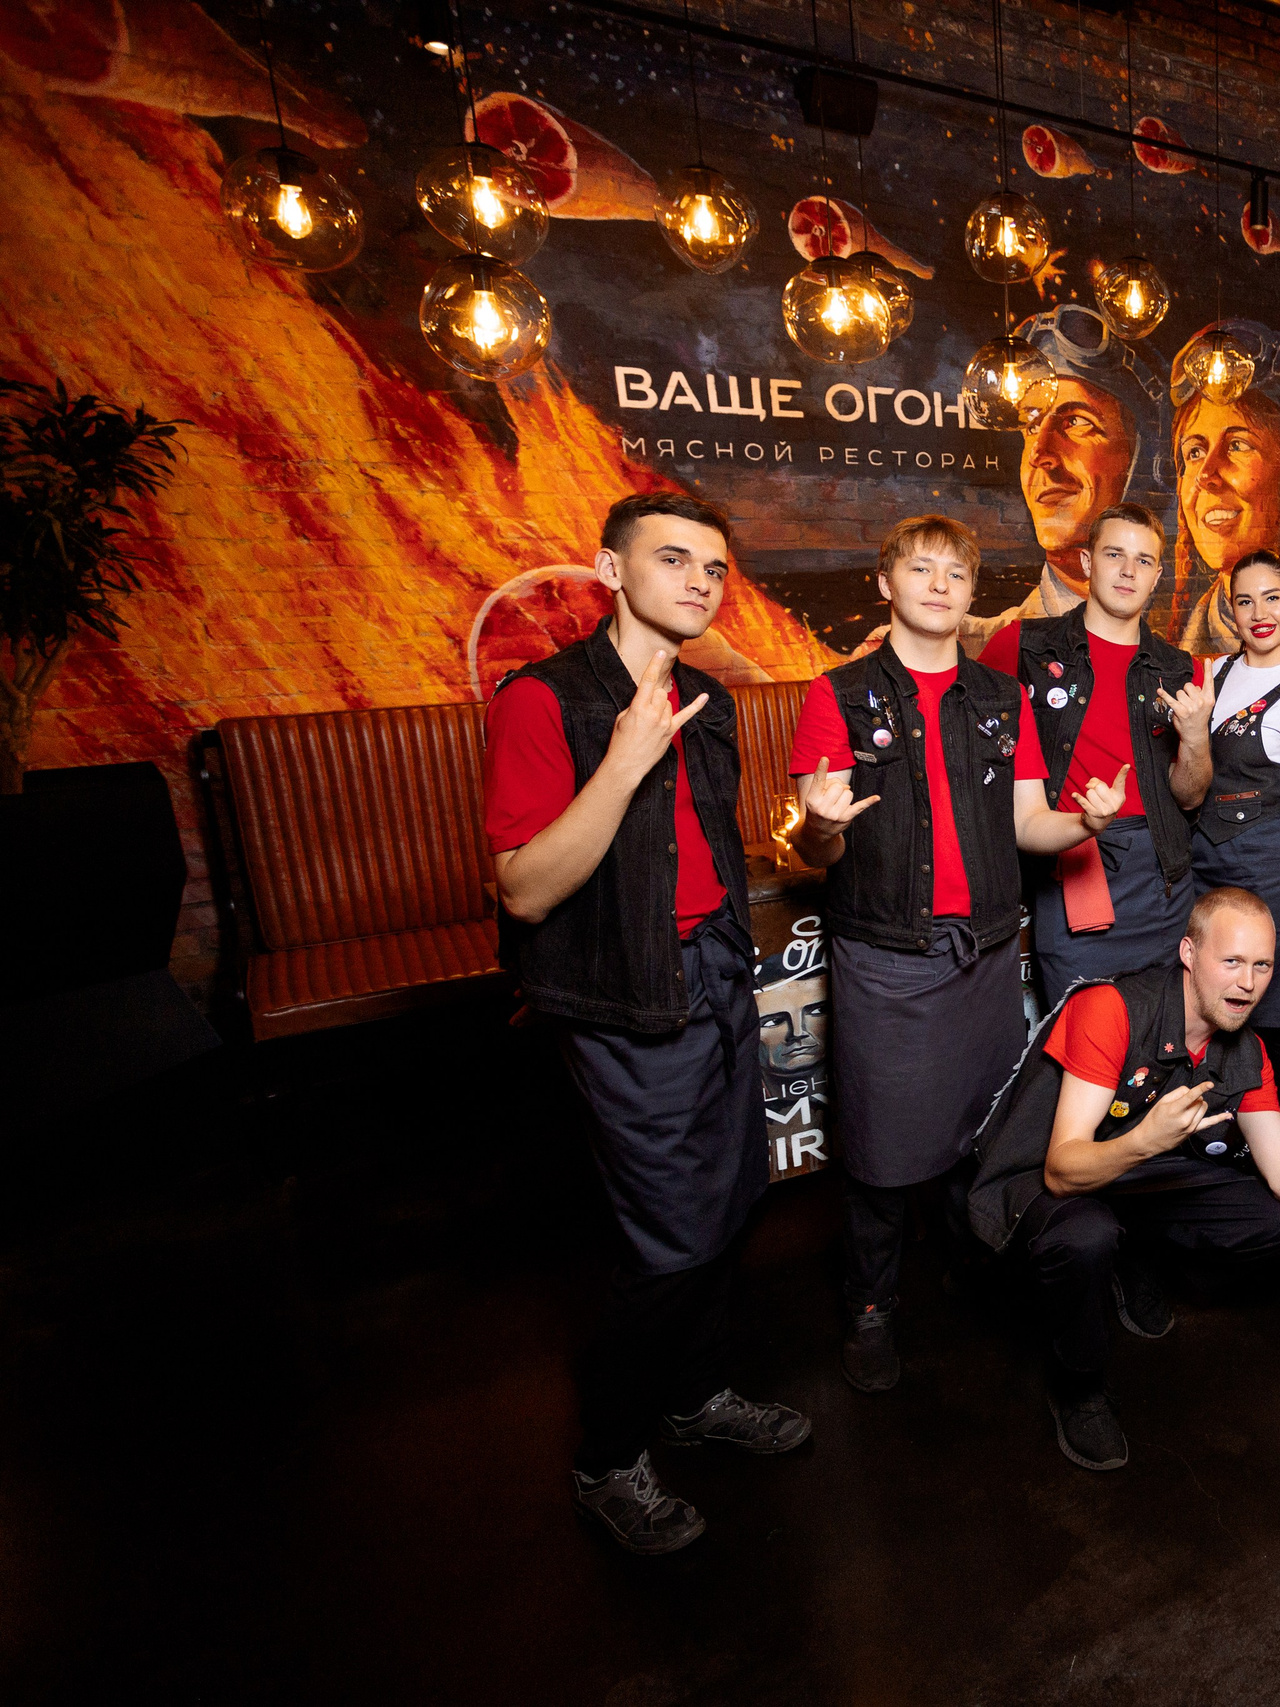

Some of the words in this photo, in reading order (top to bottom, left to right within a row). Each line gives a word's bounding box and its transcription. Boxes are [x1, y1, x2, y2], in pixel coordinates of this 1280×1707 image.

[614, 365, 805, 422] ВАЩЕ
[621, 436, 793, 463] МЯСНОЙ
[819, 446, 1000, 471] РЕСТОРАН
[762, 1075, 828, 1102] LIGH
